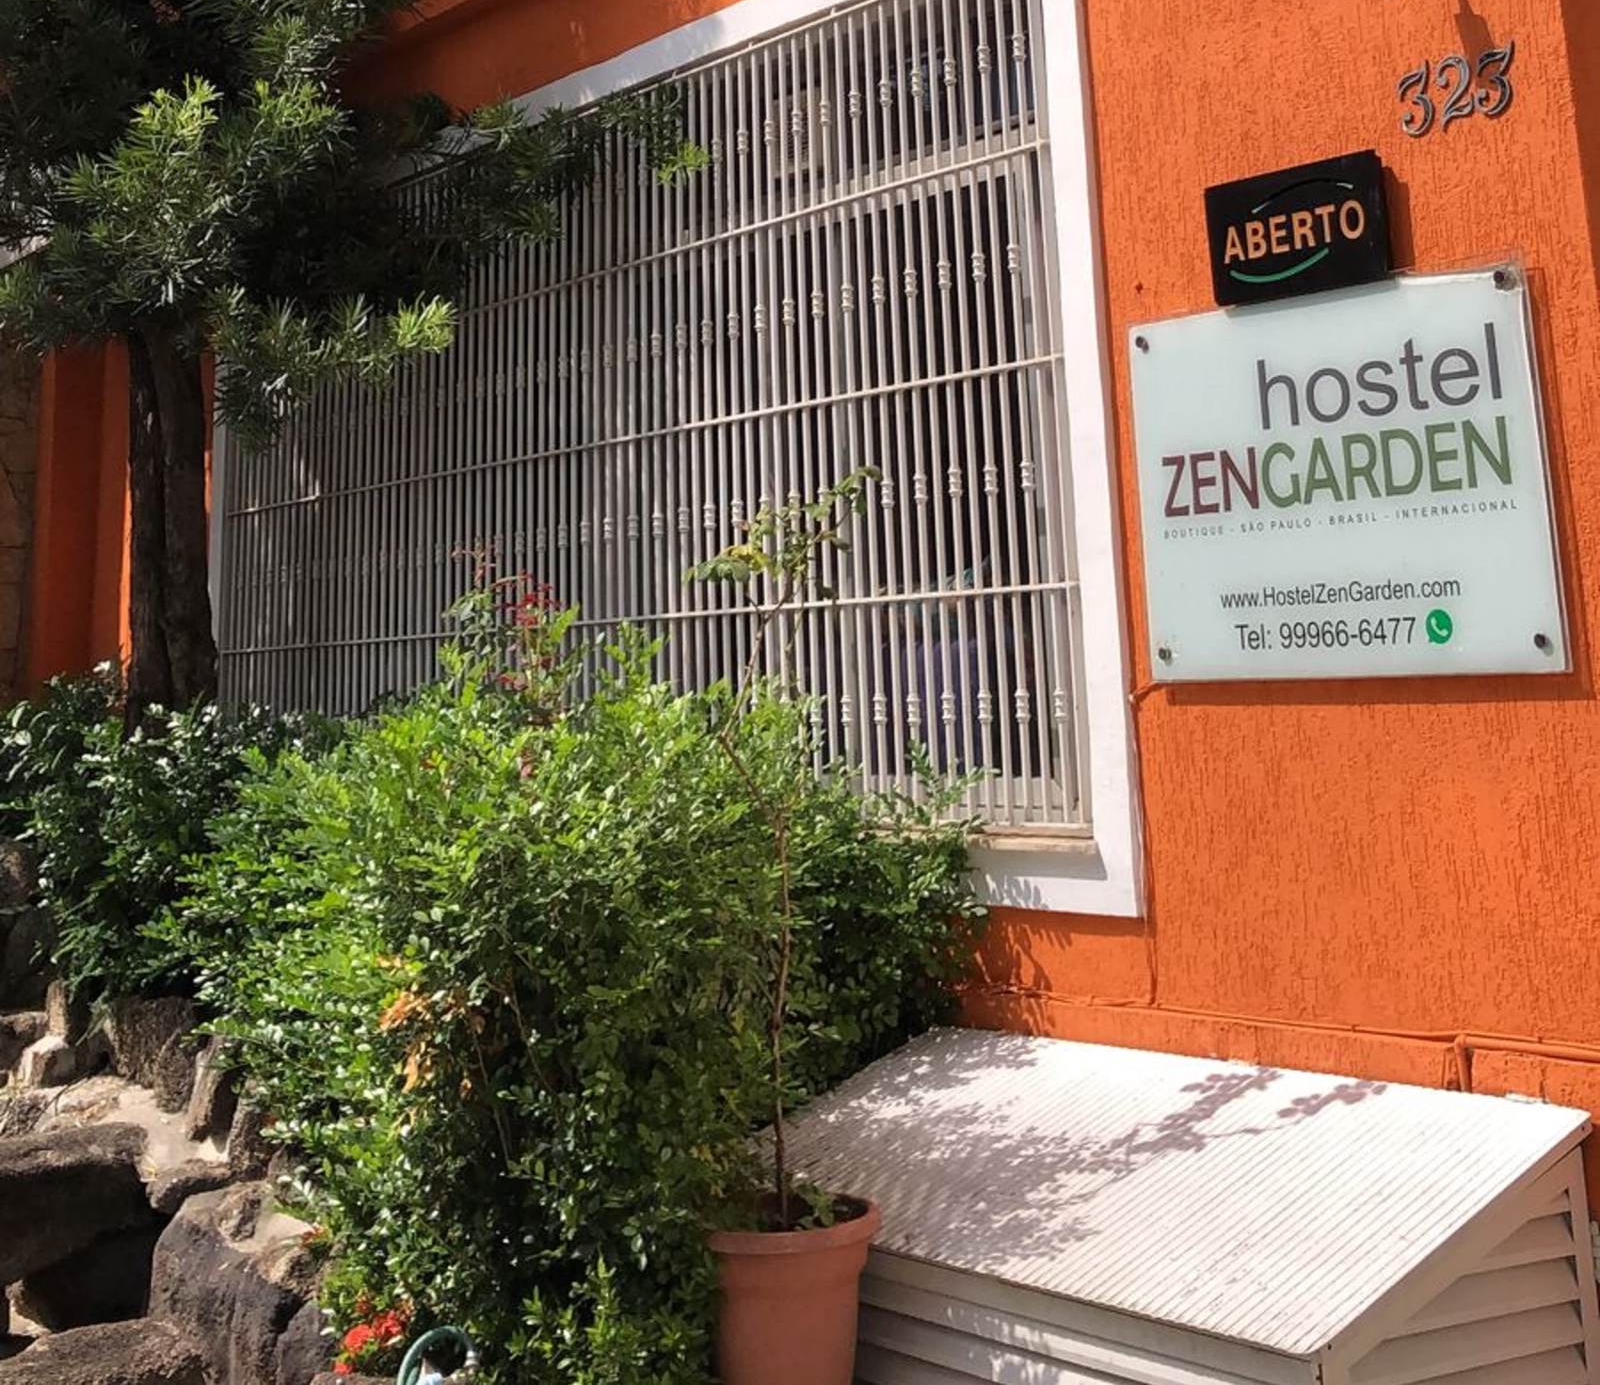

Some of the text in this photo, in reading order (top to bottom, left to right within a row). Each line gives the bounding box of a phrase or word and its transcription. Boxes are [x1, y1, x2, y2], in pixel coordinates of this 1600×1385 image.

[1398, 40, 1515, 137] 323
[1223, 199, 1365, 264] ABERTO
[1256, 322, 1503, 430] hostel
[1164, 525, 1224, 539] BOUTIQUE
[1271, 518, 1312, 530] PAULO
[1329, 512, 1377, 525] BRASIL
[1395, 499, 1517, 519] INTERNACIONAL
[1220, 578, 1461, 609] www.HostelZenGarden.com
[1235, 617, 1416, 650] Tel: 99966-6477
